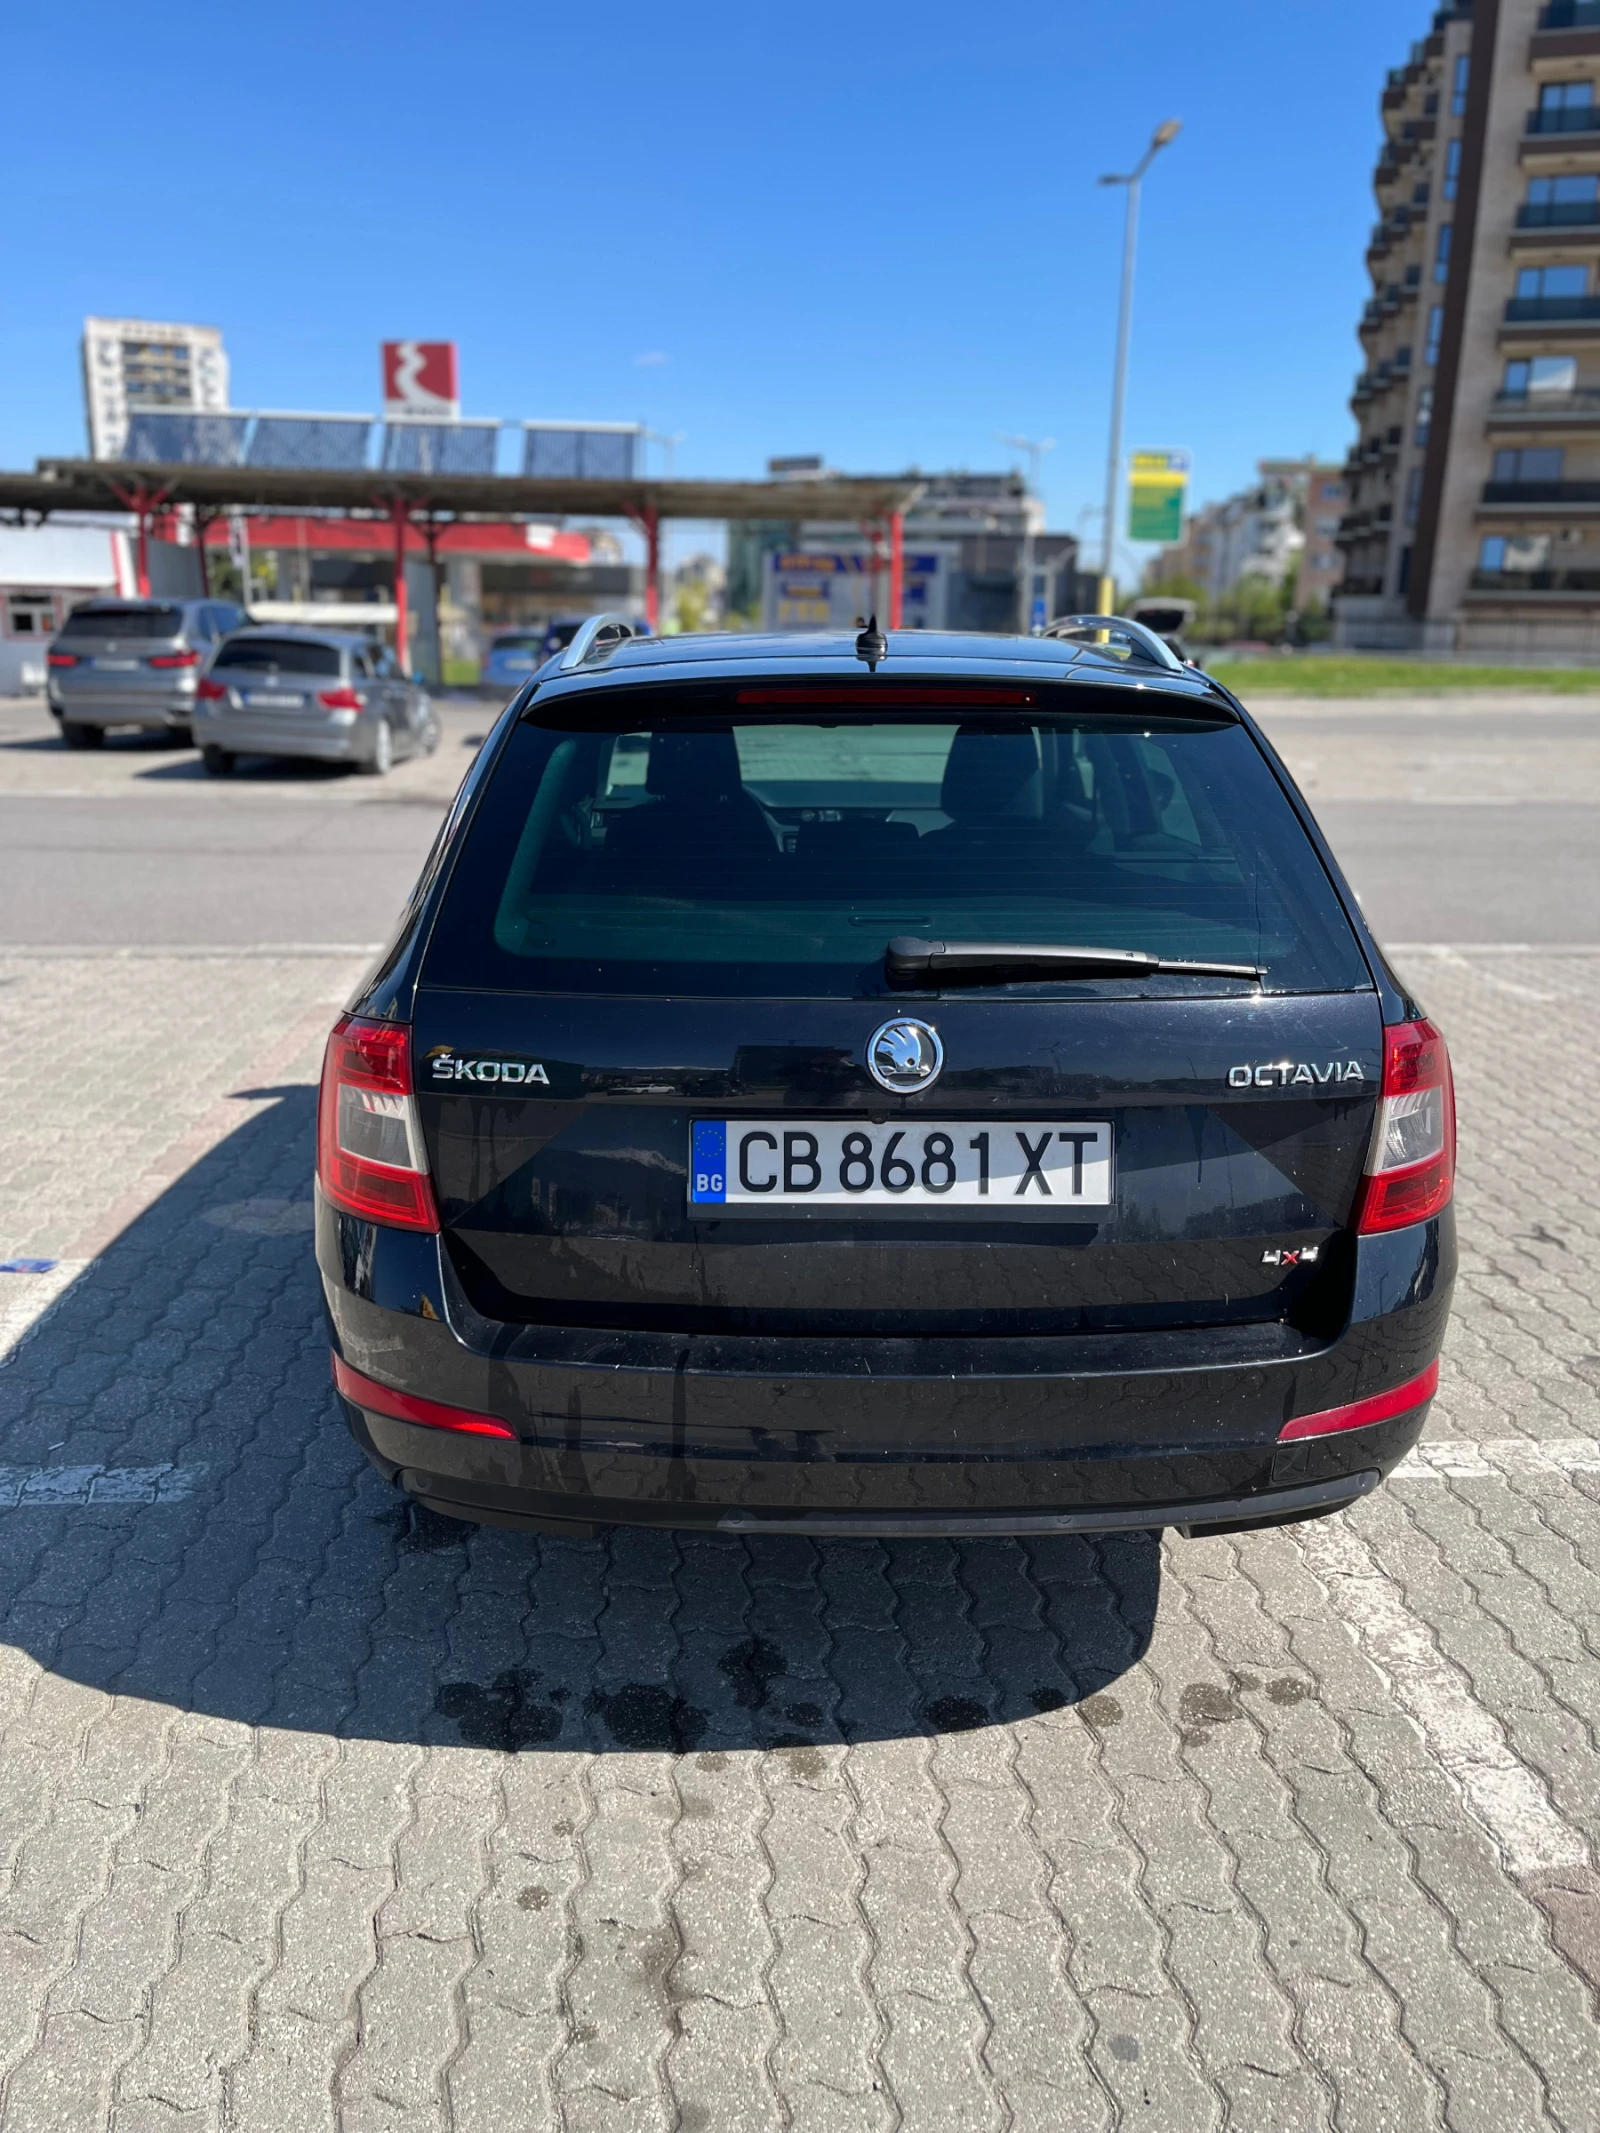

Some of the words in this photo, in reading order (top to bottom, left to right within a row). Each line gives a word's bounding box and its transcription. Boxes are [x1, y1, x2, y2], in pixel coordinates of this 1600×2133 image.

[431, 1053, 550, 1085] ŠKODA
[1228, 1060, 1365, 1087] OCTAVIA
[738, 1131, 822, 1194] CB
[838, 1131, 991, 1194] 8681
[1013, 1131, 1099, 1195] XT
[696, 1173, 723, 1193] BG
